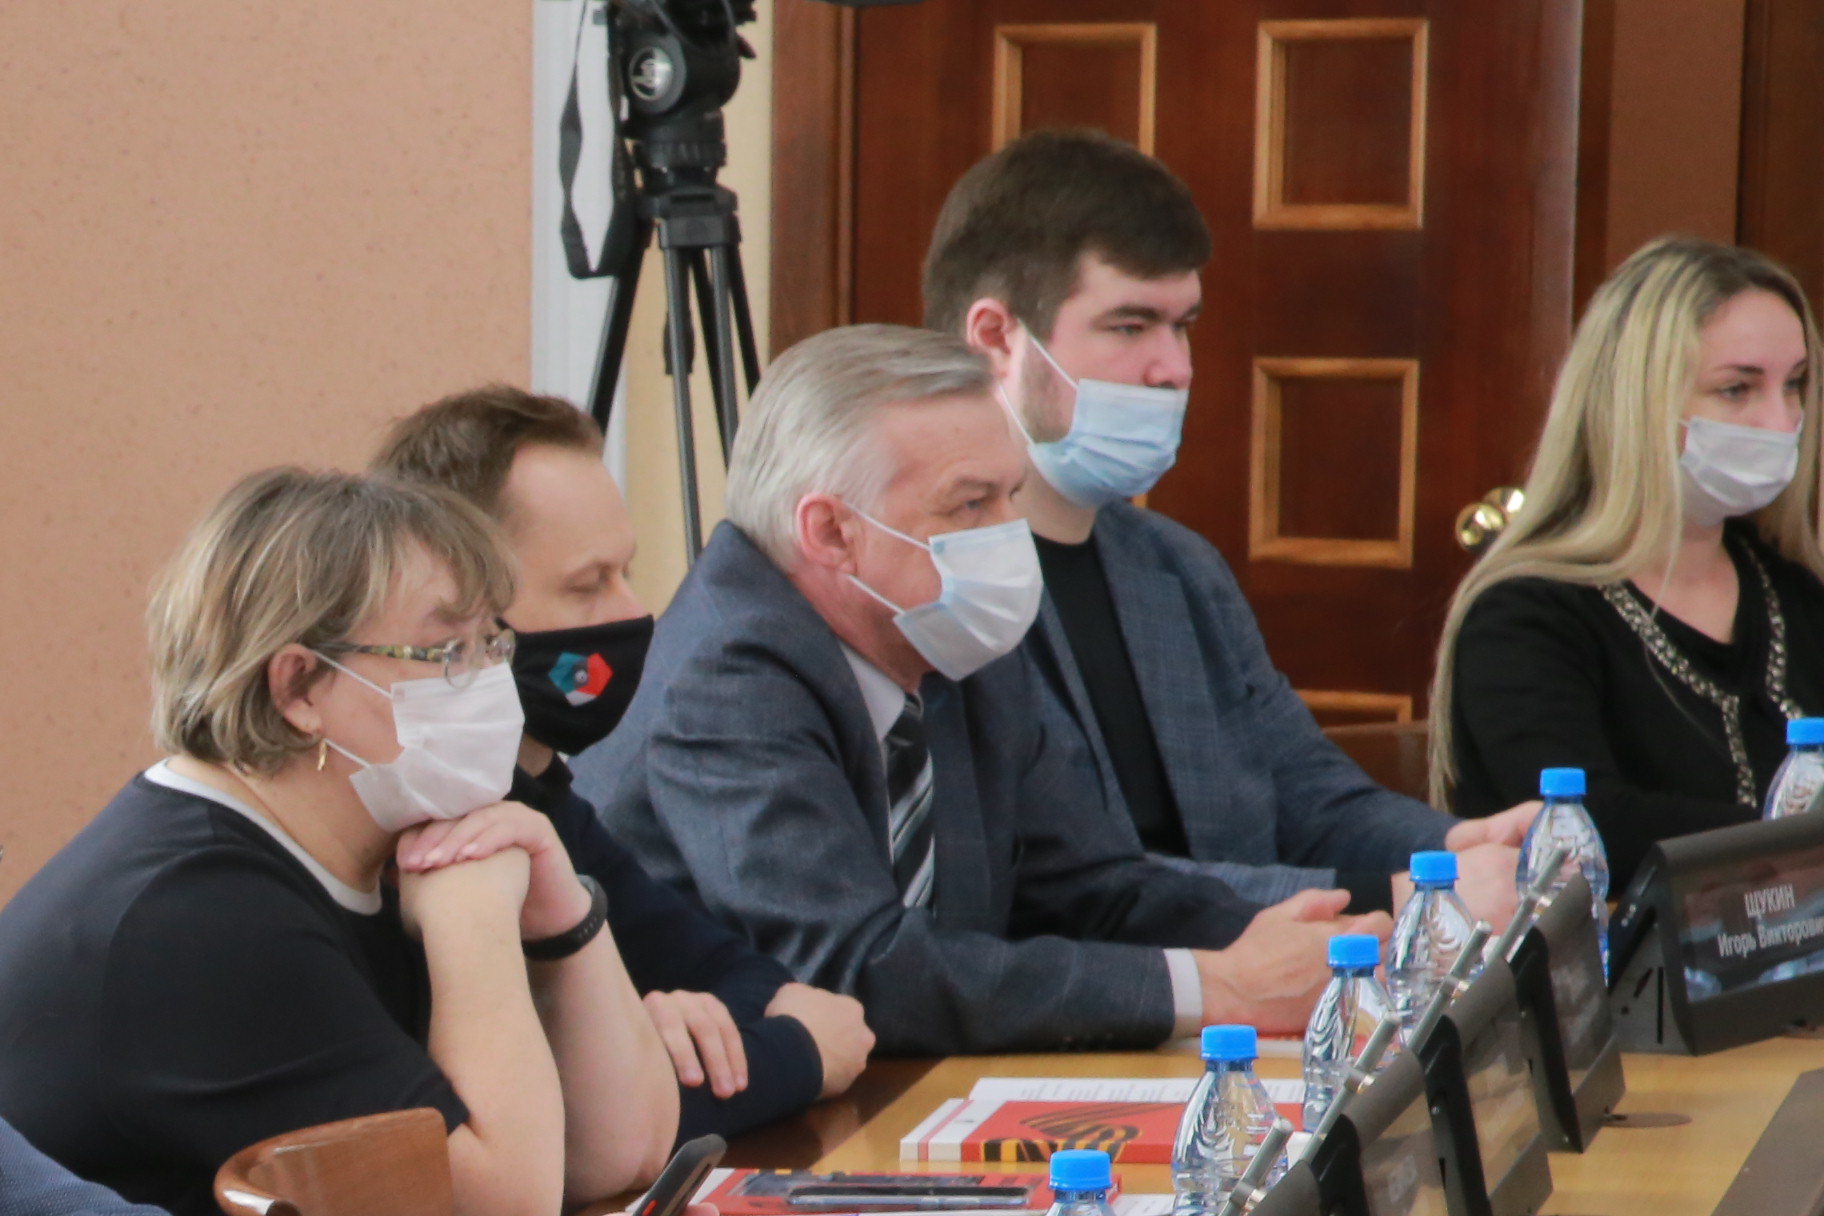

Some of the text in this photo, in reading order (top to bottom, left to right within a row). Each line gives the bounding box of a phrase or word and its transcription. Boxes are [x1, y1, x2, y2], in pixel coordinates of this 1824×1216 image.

[1744, 883, 1796, 920] ЩУКИН
[1717, 915, 1824, 959] Игорь Викторови
